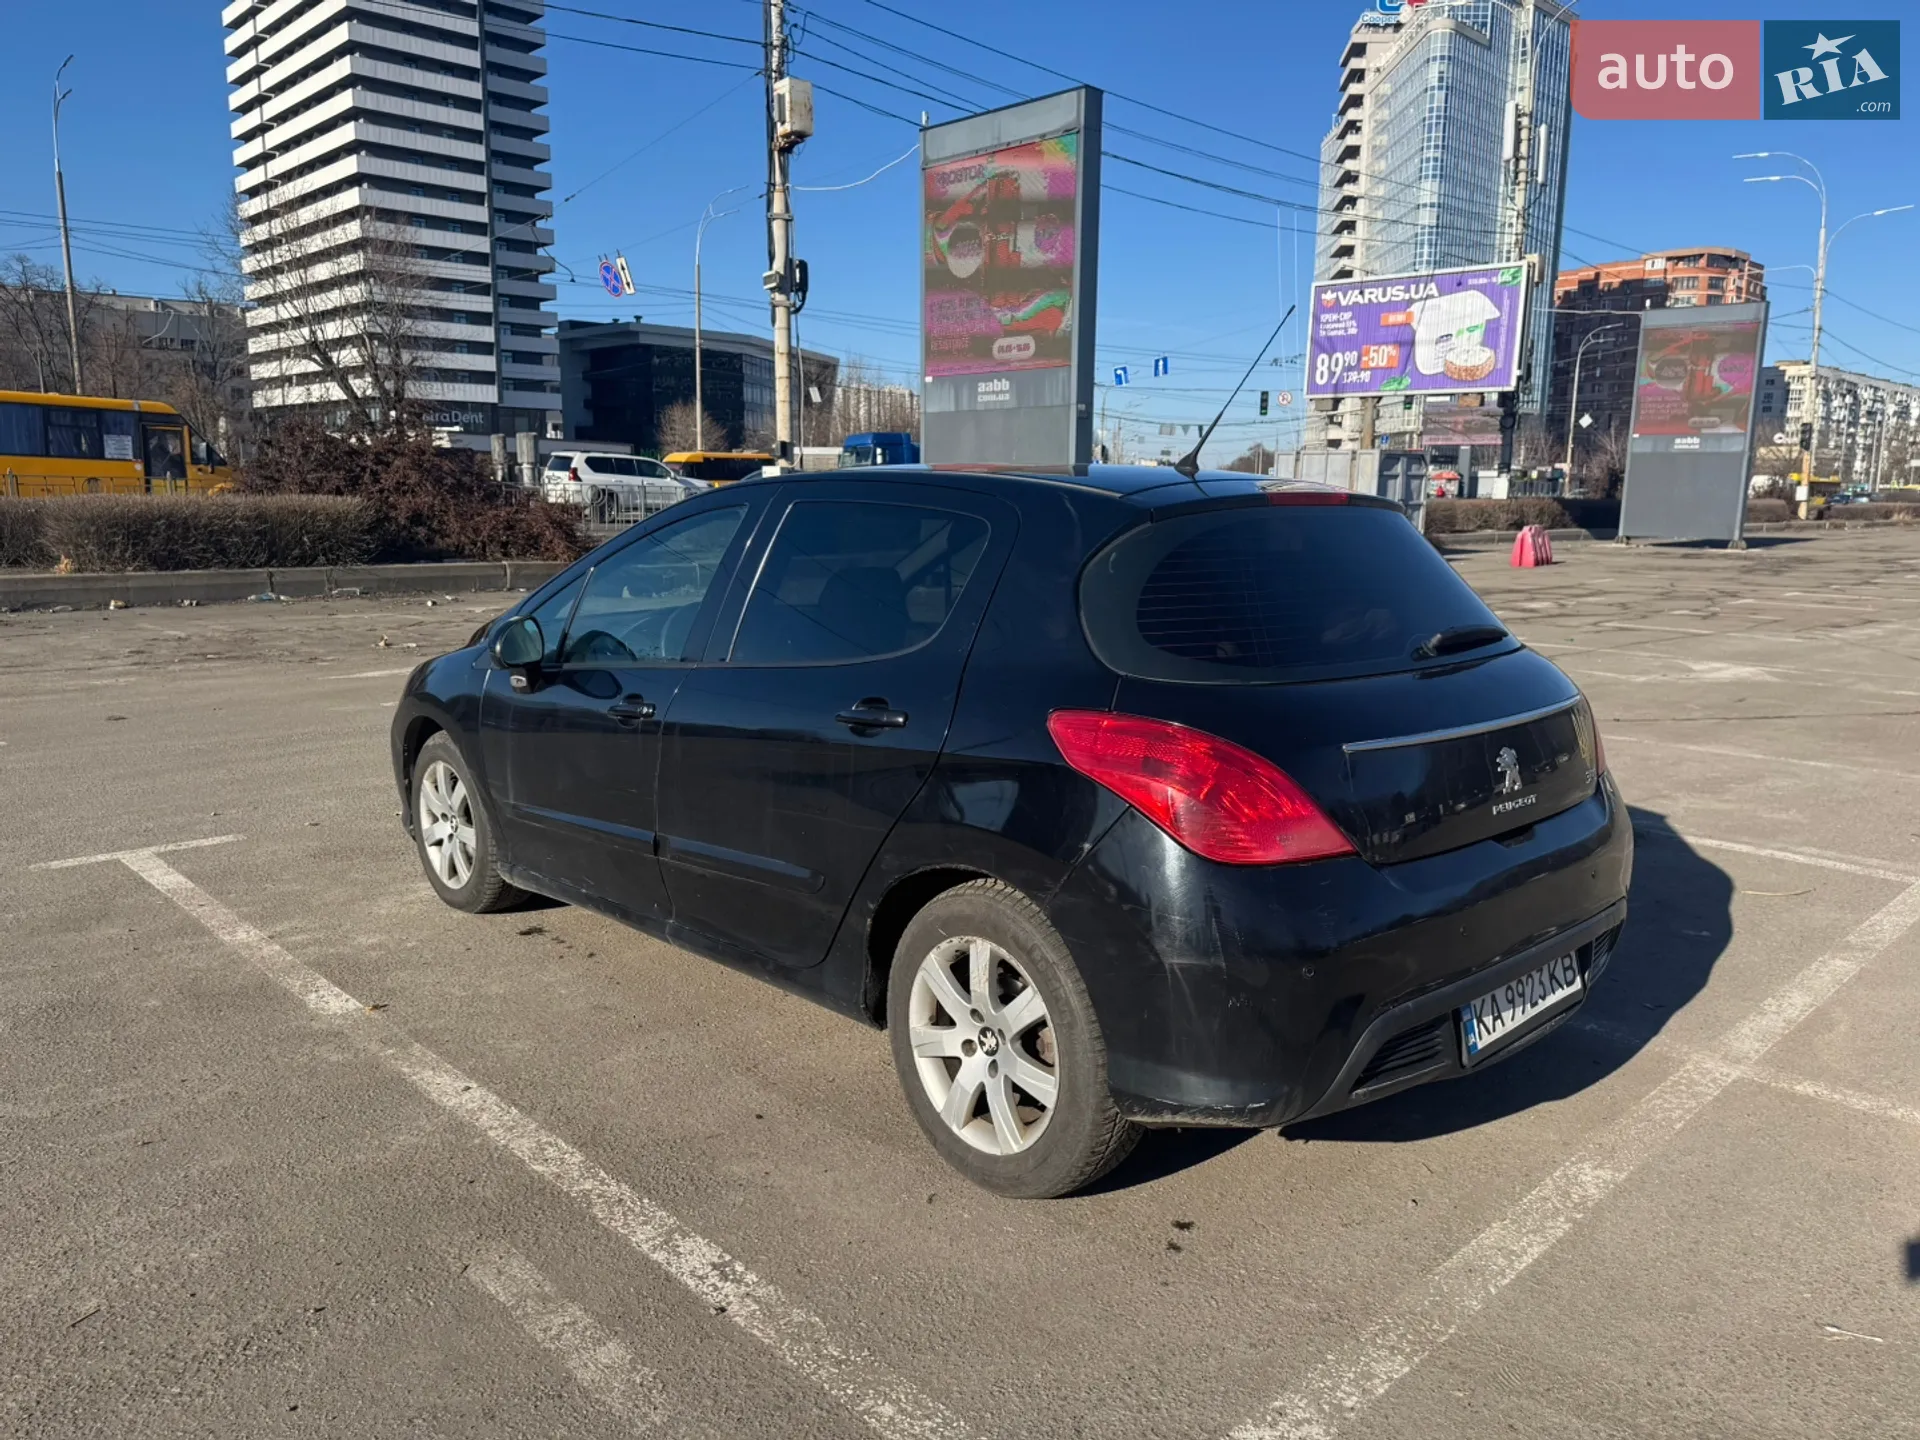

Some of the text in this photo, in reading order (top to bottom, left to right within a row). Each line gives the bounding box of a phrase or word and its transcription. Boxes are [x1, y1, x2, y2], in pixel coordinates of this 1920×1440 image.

[1361, 13, 1399, 26] Cooper
[1338, 282, 1439, 307] VARUS.UA
[1361, 345, 1397, 367] -50%
[978, 378, 1010, 392] aabb
[977, 393, 1010, 402] com.ua
[1492, 794, 1537, 815] PEUGEOT
